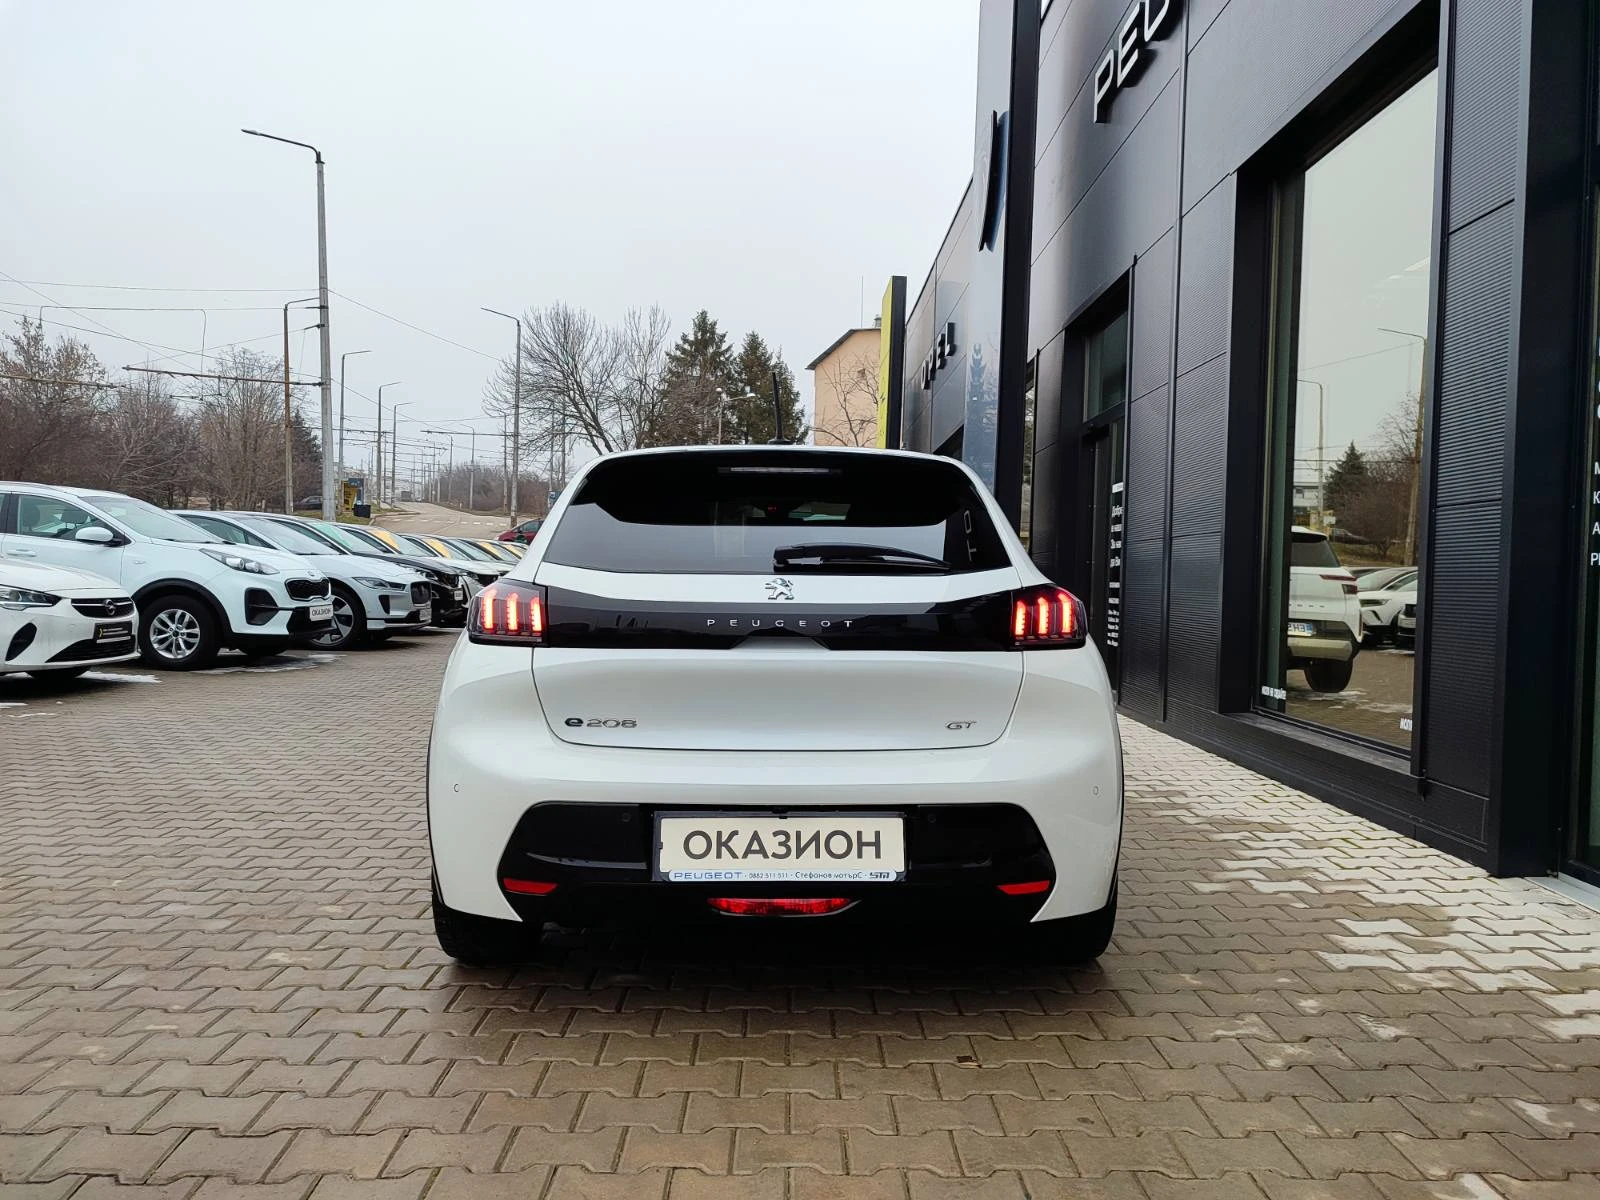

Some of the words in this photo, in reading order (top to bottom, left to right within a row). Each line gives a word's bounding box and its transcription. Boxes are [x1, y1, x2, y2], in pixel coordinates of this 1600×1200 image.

[920, 322, 953, 390] OPEL
[707, 618, 853, 628] PEUGEOT
[944, 720, 977, 730] GT
[683, 829, 881, 860] ОКАЗИОН
[674, 871, 742, 880] PEUGEOT
[795, 871, 832, 880] Стефанов
